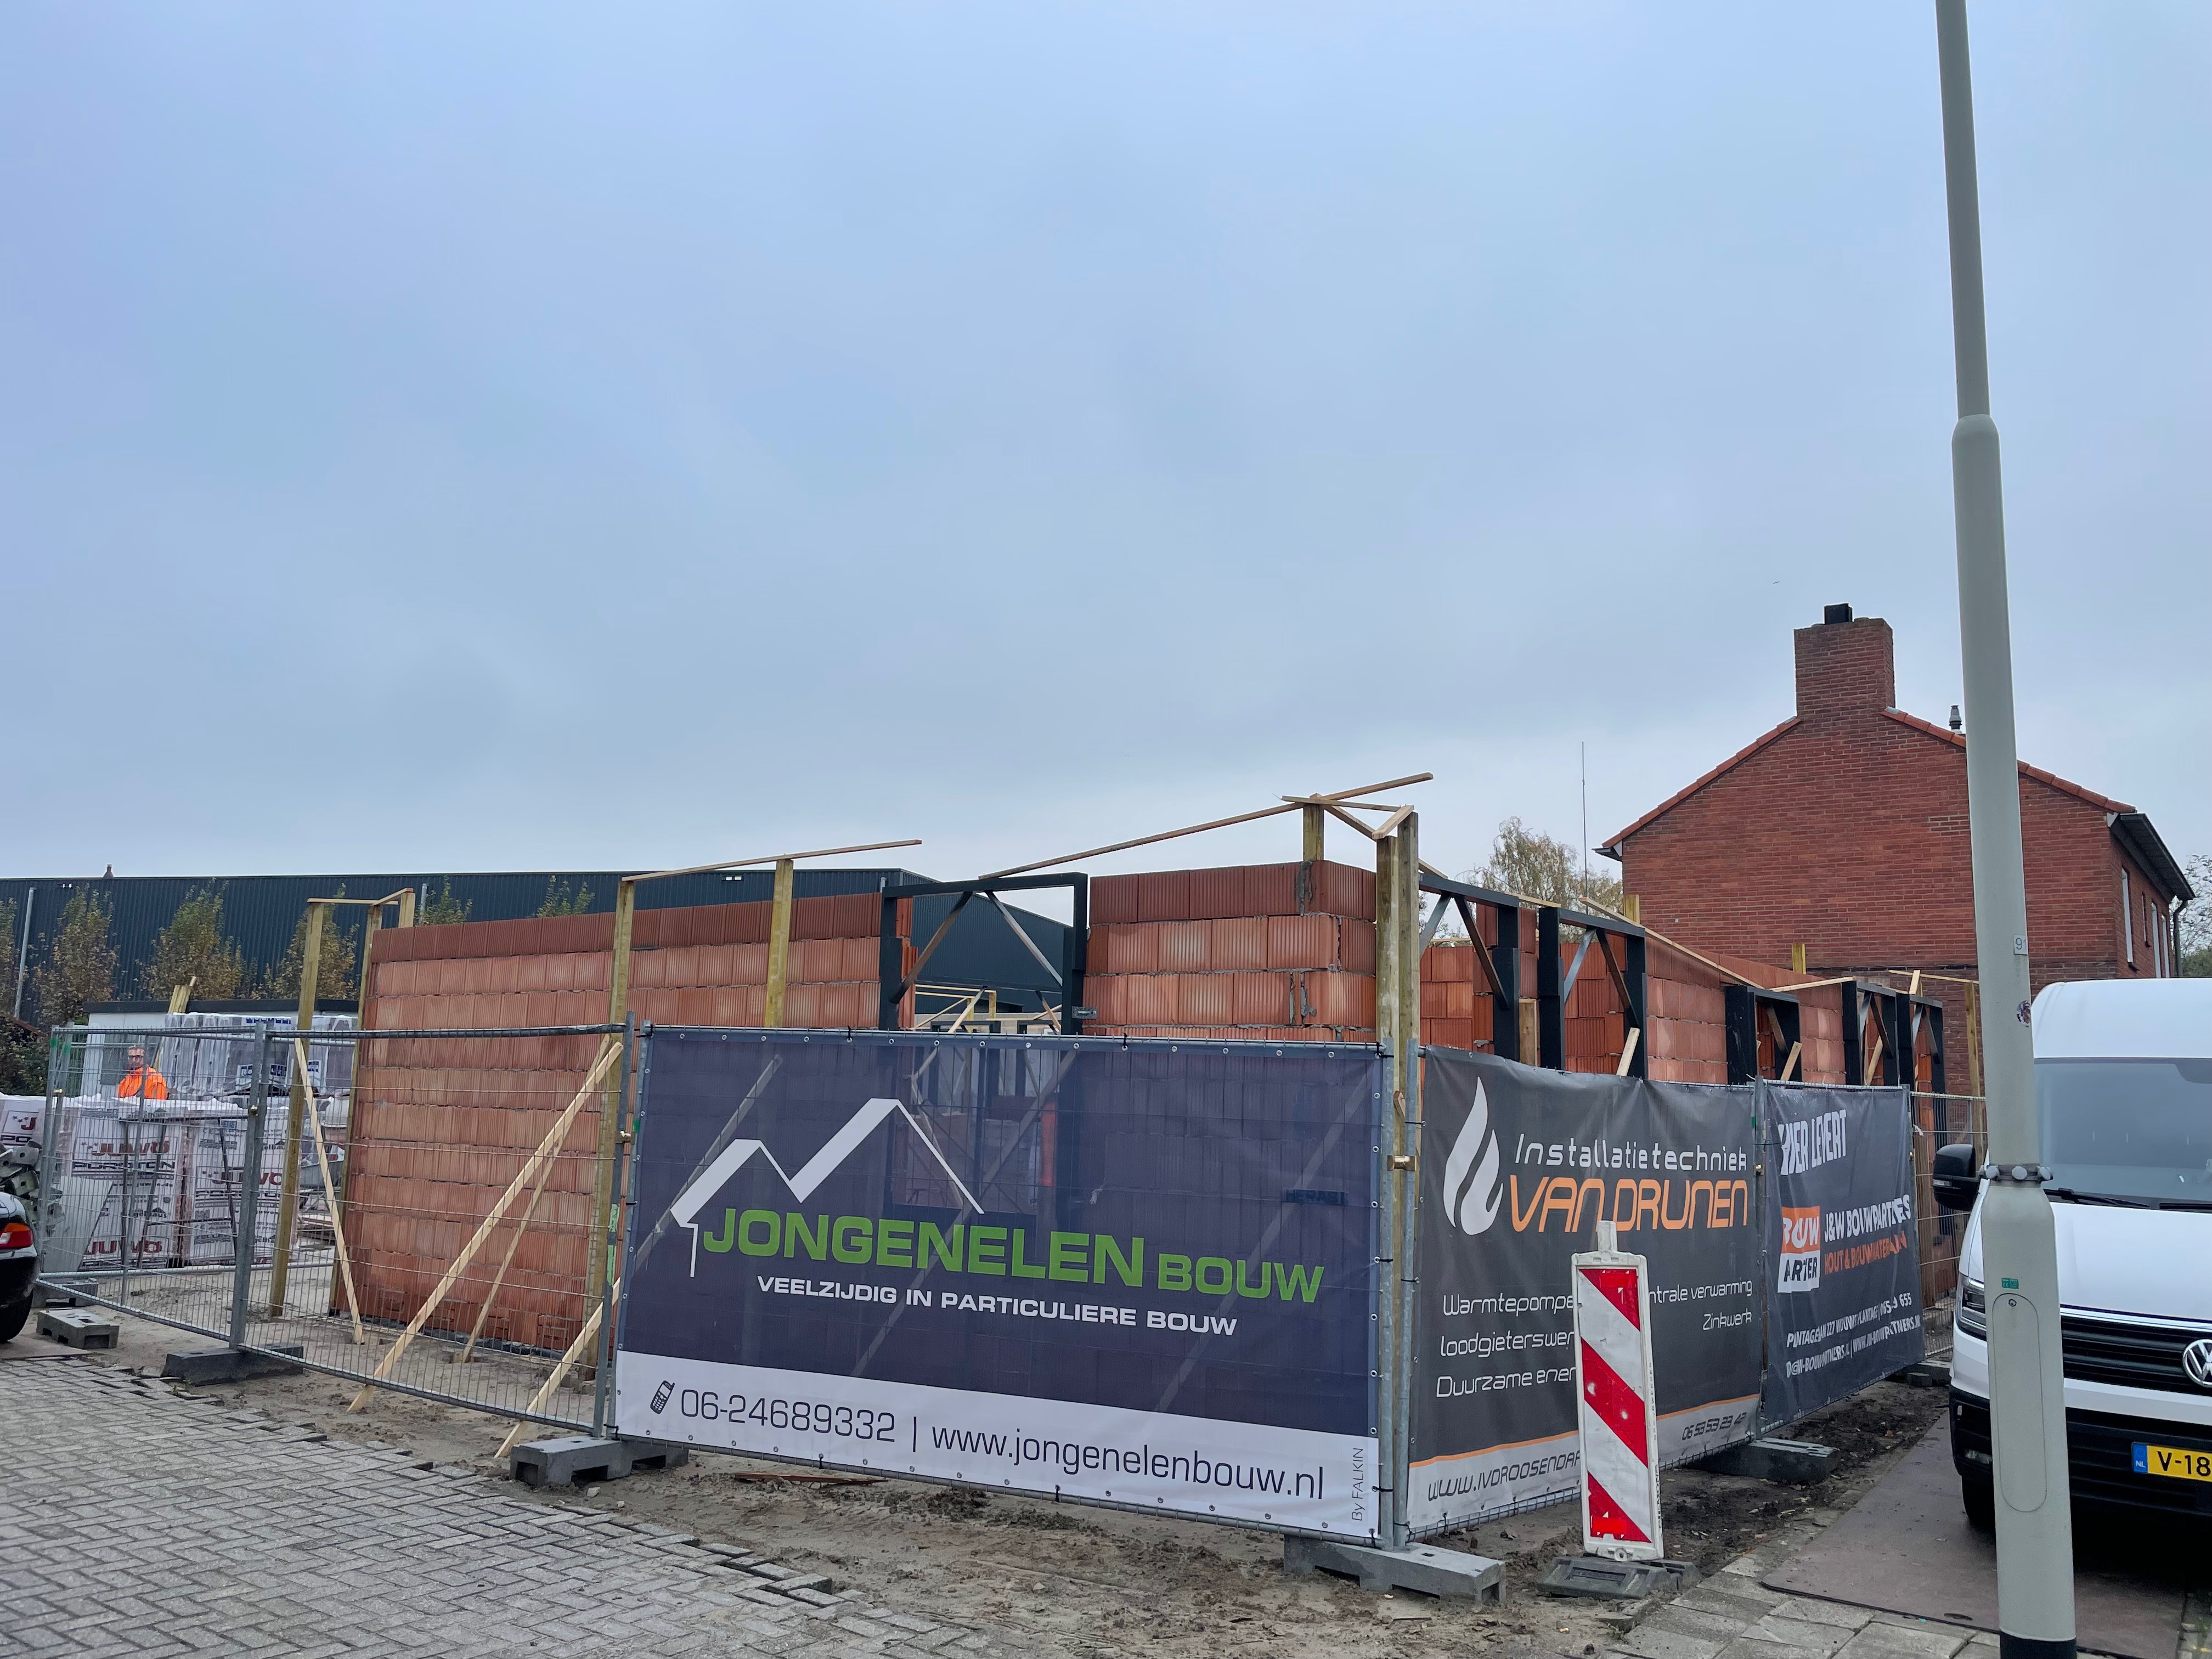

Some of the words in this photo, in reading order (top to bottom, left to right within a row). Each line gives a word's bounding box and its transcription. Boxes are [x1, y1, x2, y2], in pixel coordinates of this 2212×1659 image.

[1515, 1133, 1747, 1171] Installatietechniek
[1510, 1175, 1605, 1232] VAN
[1613, 1178, 1748, 1231] DRUNEN
[1825, 1211, 1845, 1242] J&W
[703, 1209, 1144, 1287] JONGENELEN
[1158, 1253, 1324, 1303] BOUW
[758, 1276, 897, 1304] VEELZIJDIG
[906, 1289, 932, 1307] IN
[941, 1293, 1137, 1326] PARTICULIERE
[1147, 1311, 1237, 1336] BOUW
[1443, 1293, 1573, 1317] Warmtepompe
[1649, 1285, 1688, 1304] ntrale
[1691, 1279, 1752, 1300] verwarming
[1899, 1293, 1912, 1307] 655
[1703, 1308, 1752, 1330] Zinkwerk
[1440, 1330, 1575, 1358] loodgieterswer
[1436, 1372, 1533, 1397] Duurzame
[1537, 1367, 1576, 1384] ener
[1682, 1424, 1695, 1441] 06
[1694, 1421, 1706, 1437] 53
[1705, 1418, 1720, 1433] 53
[1719, 1415, 1733, 1430] 23
[681, 1389, 895, 1442] 06-24689332
[933, 1426, 1323, 1500] www.jongenelenbouw.nl
[1352, 1448, 1364, 1499] FALKIN
[1427, 1450, 1580, 1502] WWW.IVDROOSENDAA
[2135, 1460, 2146, 1468] NL
[2157, 1450, 2211, 1477] V-18
[1352, 1502, 1365, 1521] By
